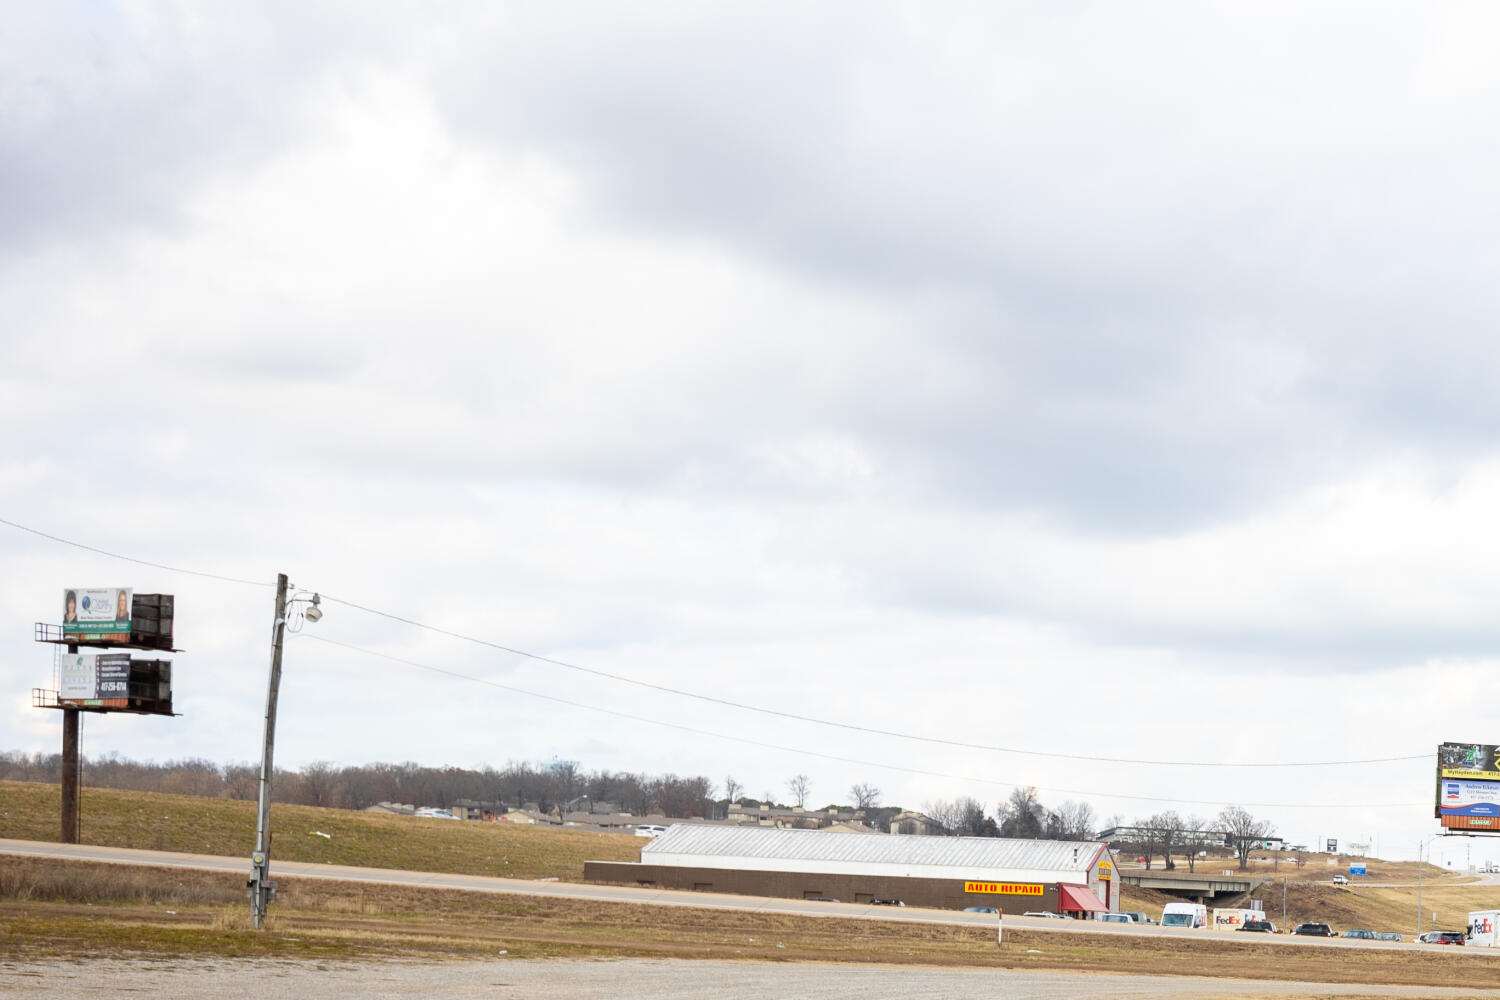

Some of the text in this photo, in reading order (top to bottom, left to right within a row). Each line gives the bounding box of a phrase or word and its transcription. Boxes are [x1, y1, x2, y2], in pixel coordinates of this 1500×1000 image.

[967, 883, 1041, 894] AUTO REPAIR
[1216, 916, 1240, 925] FedEx
[1475, 919, 1492, 934] FedEx
